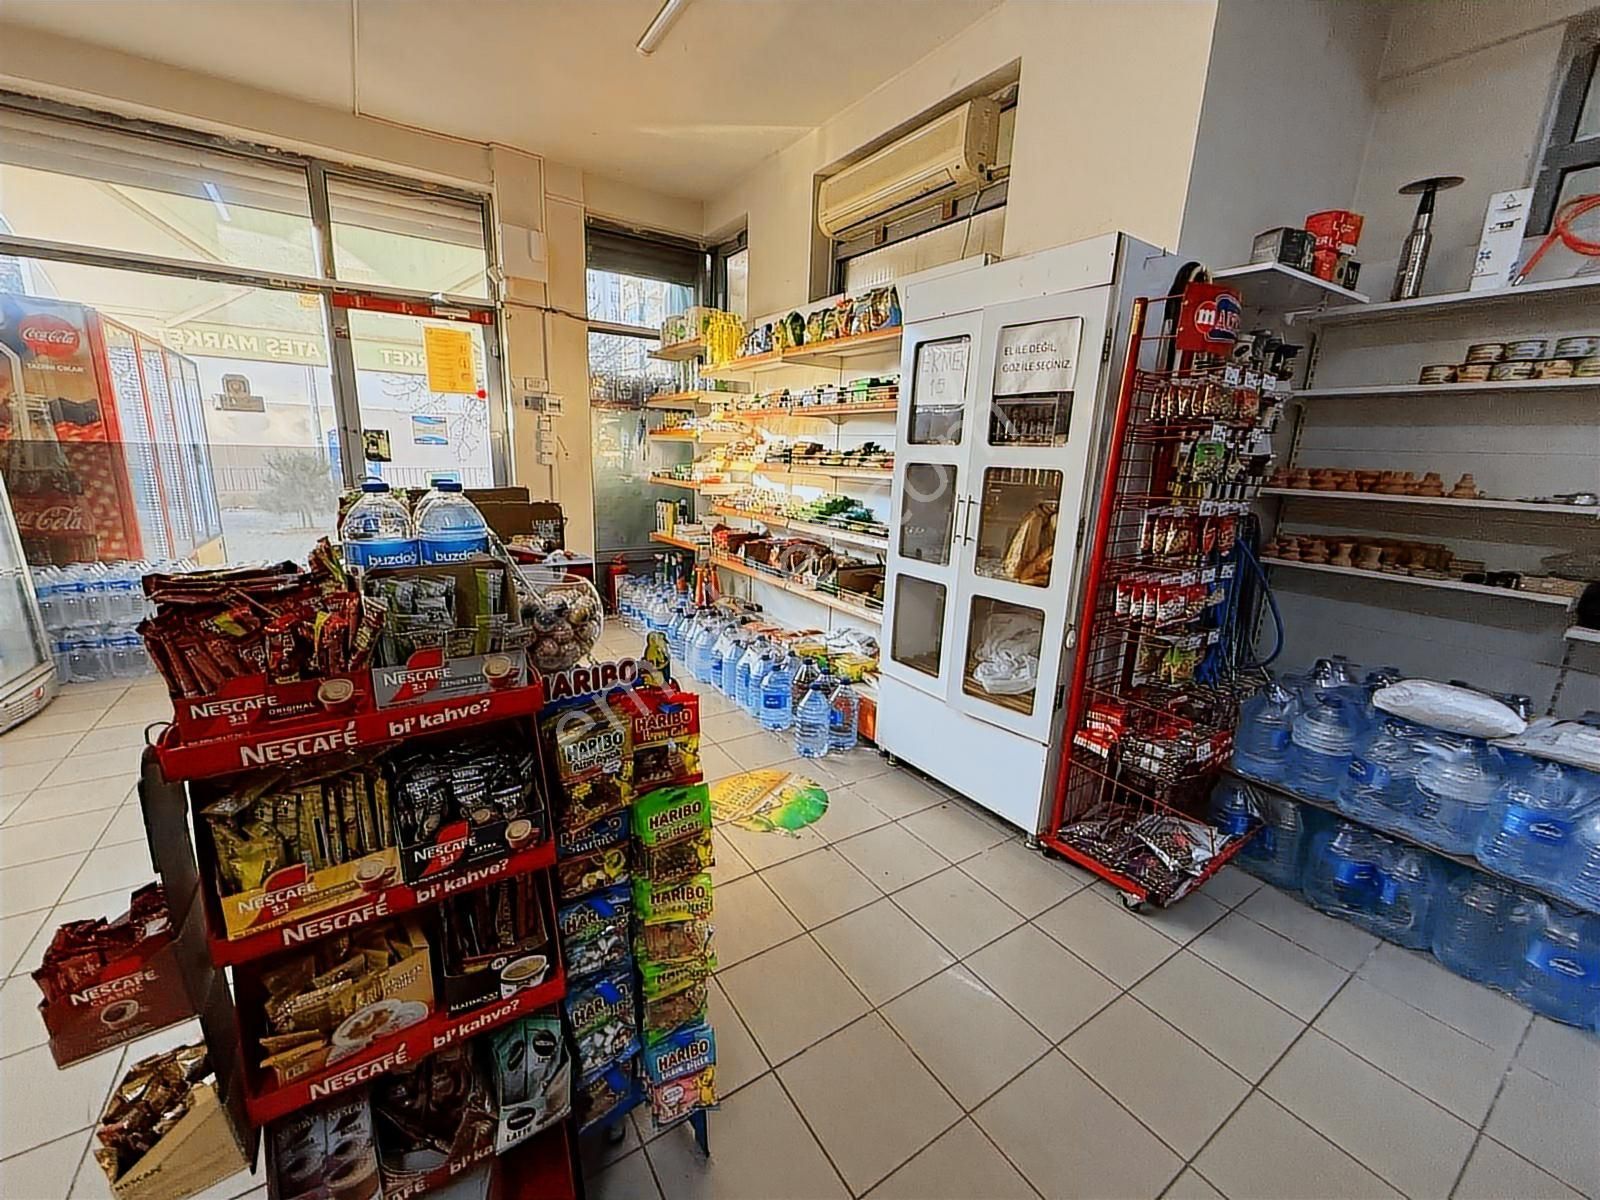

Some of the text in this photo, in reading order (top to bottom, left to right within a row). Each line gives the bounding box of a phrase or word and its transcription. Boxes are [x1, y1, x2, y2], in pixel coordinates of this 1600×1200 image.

[269, 702, 315, 715] ORIGINAL
[635, 708, 693, 734] HARIBO
[240, 720, 360, 767] NESCAFÉ
[420, 698, 491, 729] kahve?
[565, 730, 625, 764] HARIBO
[647, 801, 704, 831] HARIBO
[282, 893, 389, 946] NESCAFÉ
[444, 857, 509, 892] kahve?
[650, 885, 706, 905] HARIBO
[90, 985, 144, 1008] CLASSIC
[309, 1042, 409, 1101] NESCAFÉ
[459, 999, 520, 1036] kahve?
[657, 1039, 710, 1073] HARIBO
